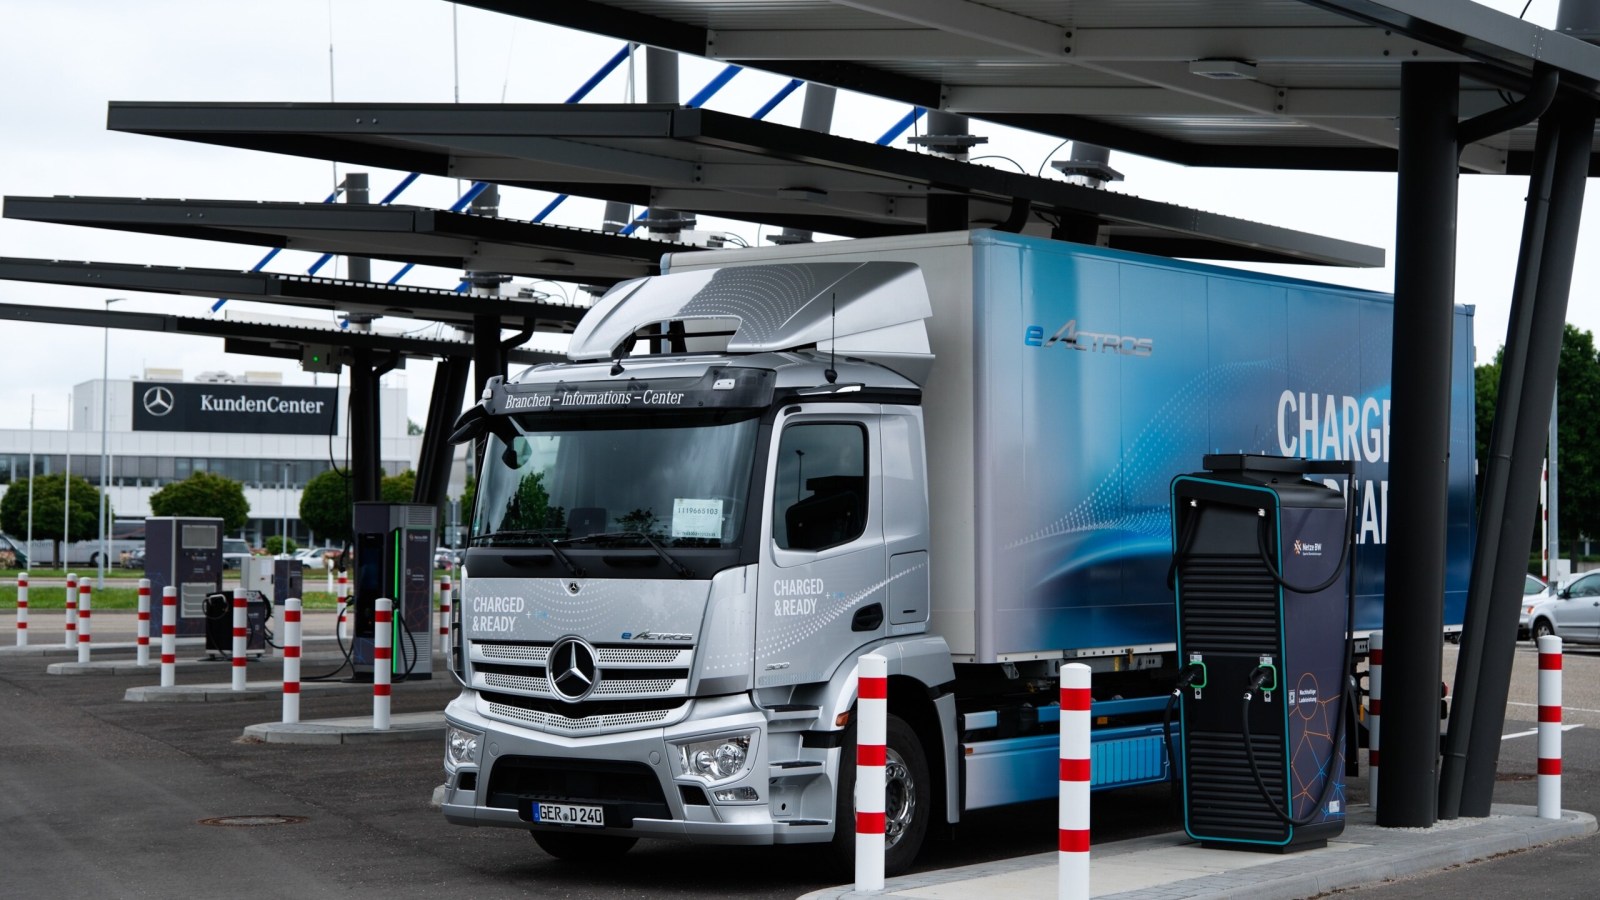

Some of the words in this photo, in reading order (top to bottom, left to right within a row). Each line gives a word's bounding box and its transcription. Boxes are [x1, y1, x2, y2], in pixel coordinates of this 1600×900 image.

[200, 394, 325, 414] KundenCenter
[505, 393, 551, 409] Branchen
[561, 390, 632, 406] Informations
[773, 578, 824, 596] CHARGED
[473, 596, 525, 613] CHARGED
[539, 805, 562, 821] GER
[569, 807, 578, 822] D
[579, 808, 603, 823] 240
